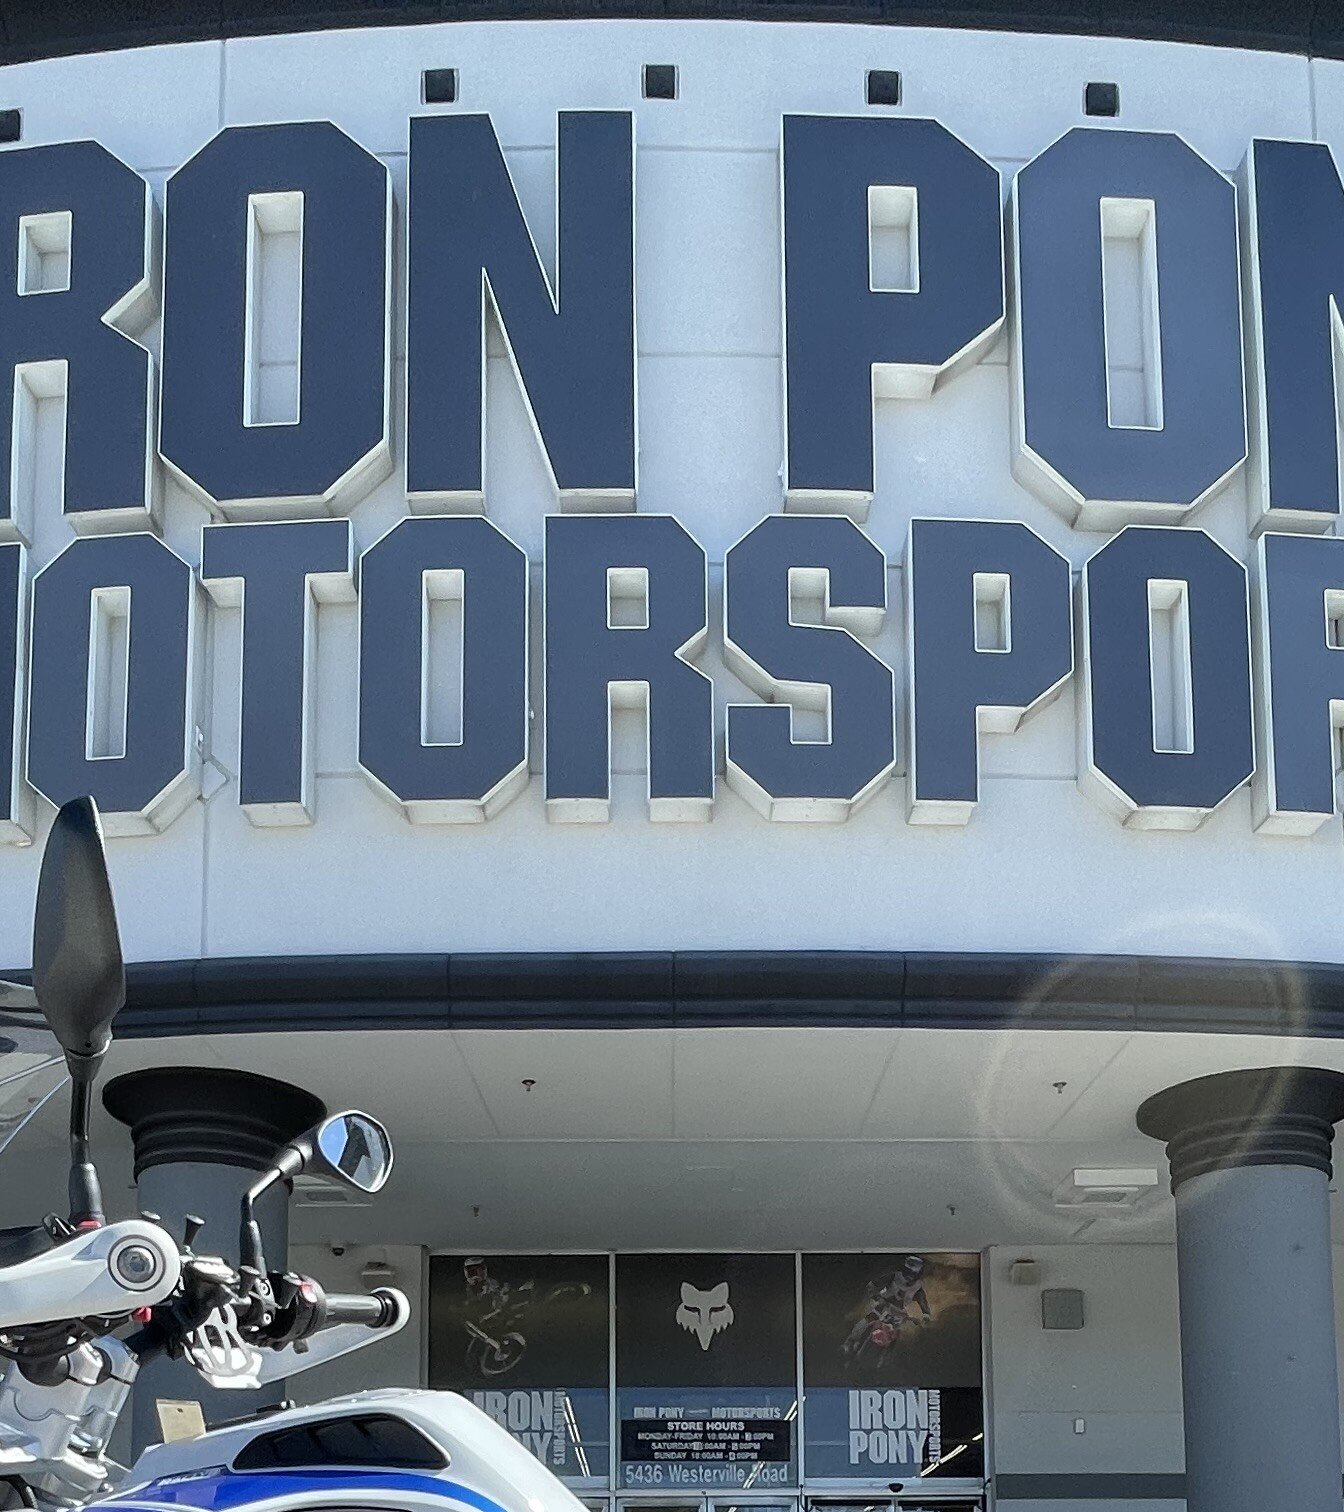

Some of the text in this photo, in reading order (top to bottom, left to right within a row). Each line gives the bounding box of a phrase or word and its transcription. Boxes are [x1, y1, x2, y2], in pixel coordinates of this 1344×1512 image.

[658, 1407, 684, 1418] PONY
[848, 1389, 928, 1430] IRON
[667, 1421, 745, 1431] STORE HOURS
[849, 1430, 928, 1464] PONY
[625, 1464, 663, 1484] 5436
[668, 1463, 745, 1484] Westerville
